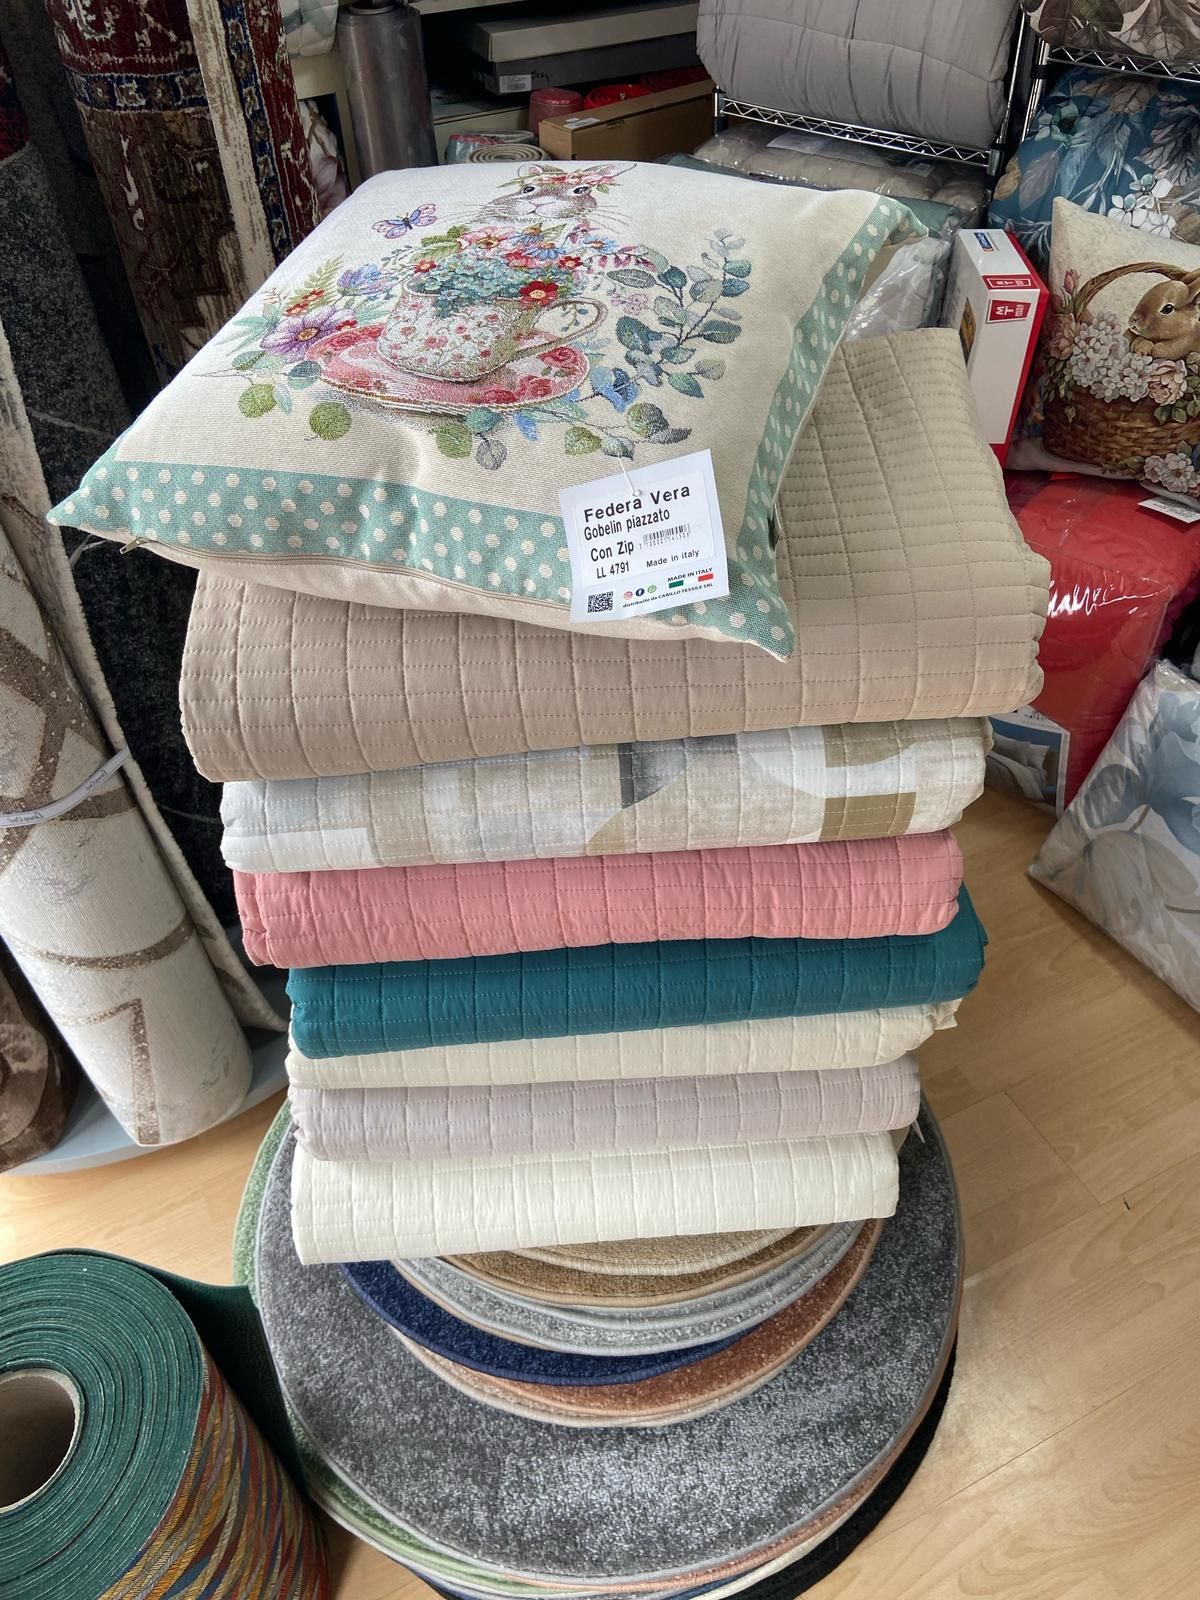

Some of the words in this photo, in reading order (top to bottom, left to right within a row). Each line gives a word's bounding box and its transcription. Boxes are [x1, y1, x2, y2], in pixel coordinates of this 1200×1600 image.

[584, 498, 642, 522] Federa
[650, 486, 691, 505] Vera
[584, 521, 622, 541] Gobelin
[626, 508, 671, 532] piazzato
[590, 547, 613, 562] Con
[617, 540, 635, 555] Zip
[646, 557, 668, 568] Made
[672, 553, 679, 561] in
[597, 567, 606, 579] LL
[609, 561, 630, 576] 4791
[667, 574, 686, 582] MADE
[695, 567, 713, 576] ITALY
